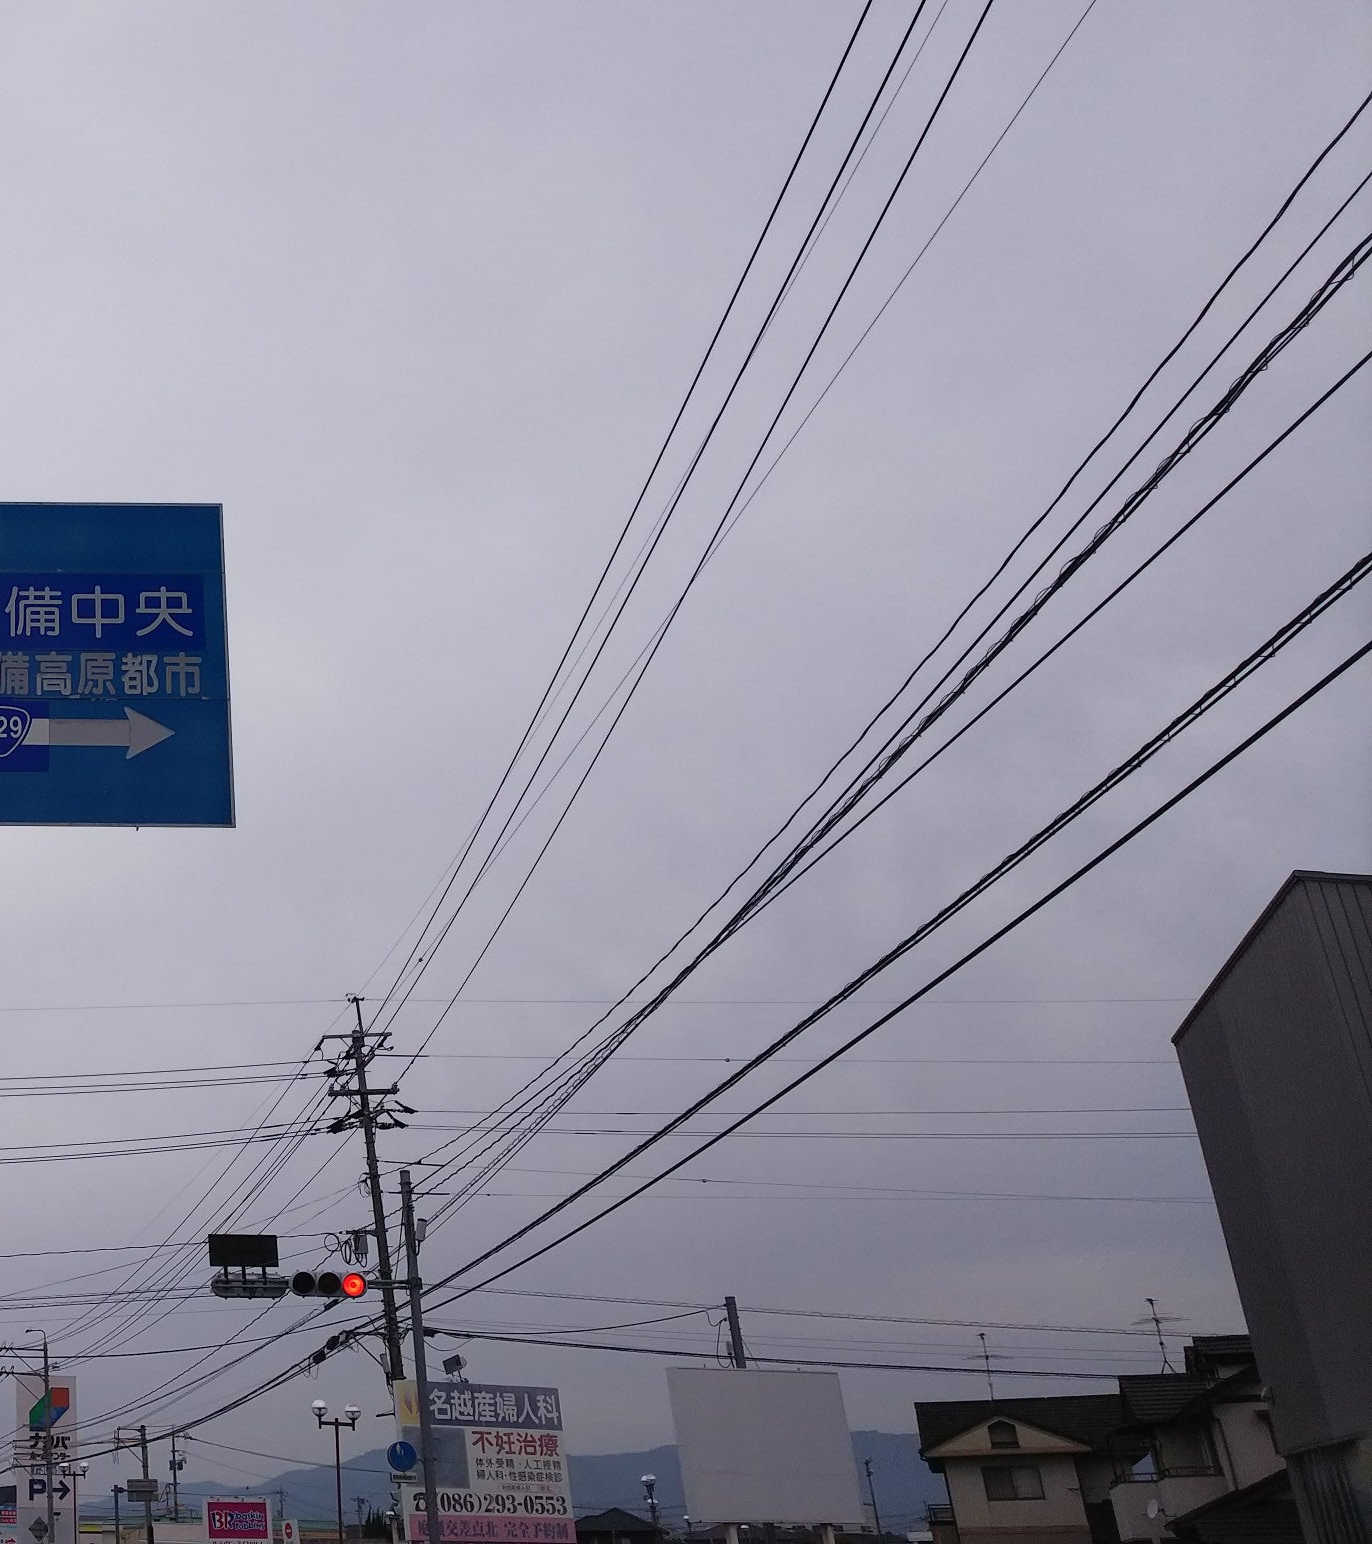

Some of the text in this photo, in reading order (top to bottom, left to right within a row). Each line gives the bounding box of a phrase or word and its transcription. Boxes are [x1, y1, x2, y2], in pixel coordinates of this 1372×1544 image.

[428, 1388, 560, 1425] 名越産婦人科
[471, 1430, 560, 1457] 不妊治療
[29, 1479, 46, 1501] P
